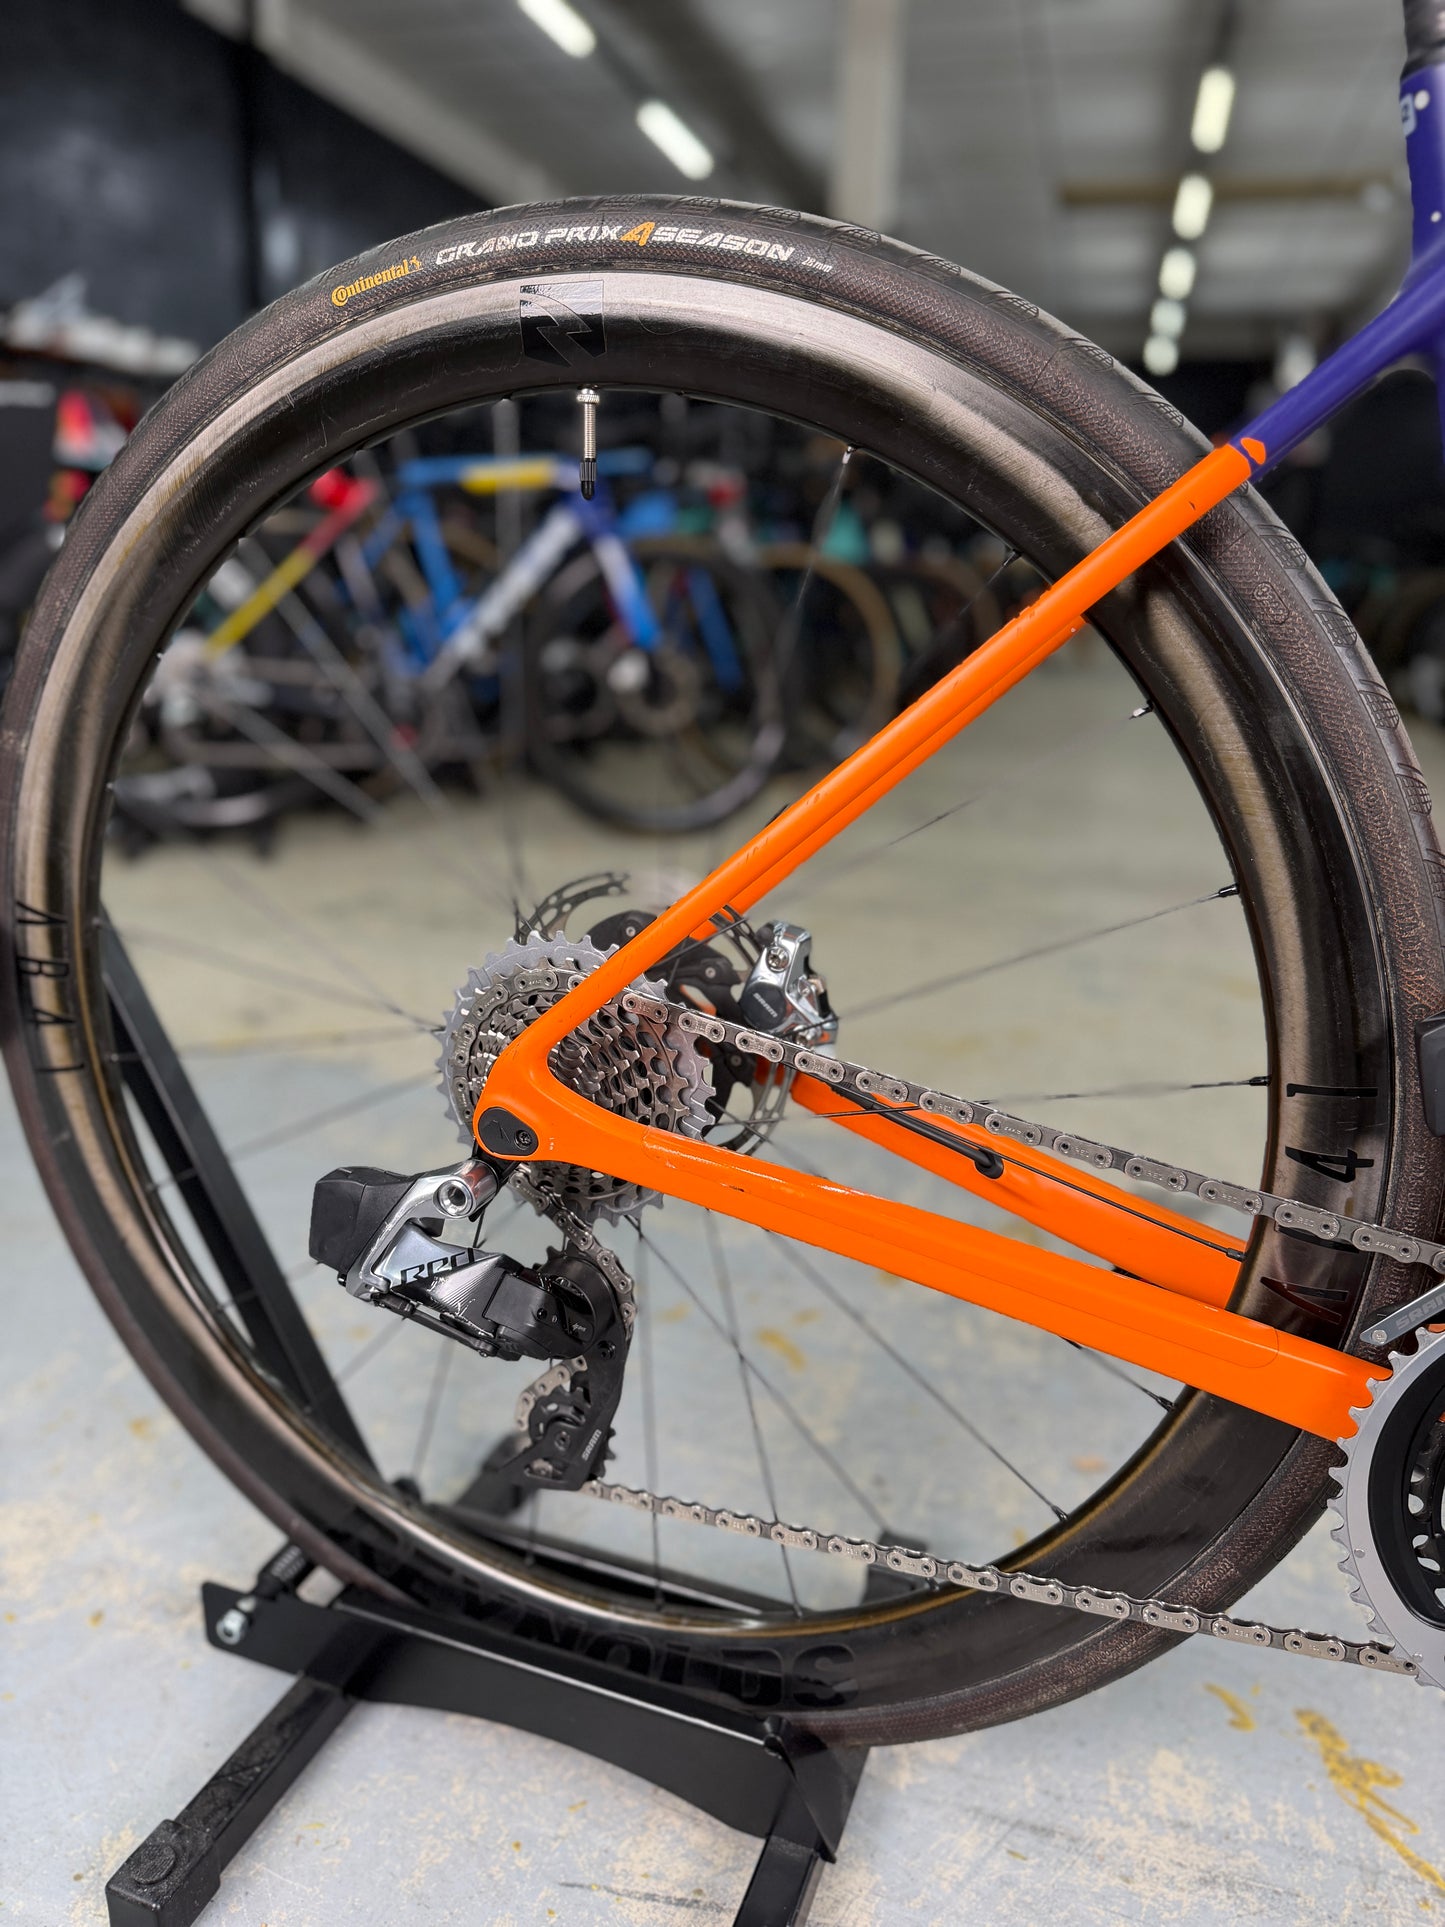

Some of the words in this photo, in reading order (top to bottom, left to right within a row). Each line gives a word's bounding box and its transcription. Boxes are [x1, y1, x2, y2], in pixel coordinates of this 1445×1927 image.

[435, 230, 540, 265] GRAND
[545, 225, 622, 244] PRIX
[652, 226, 795, 262] SEASON
[331, 258, 412, 307] Continental
[582, 1429, 602, 1461] SRAM
